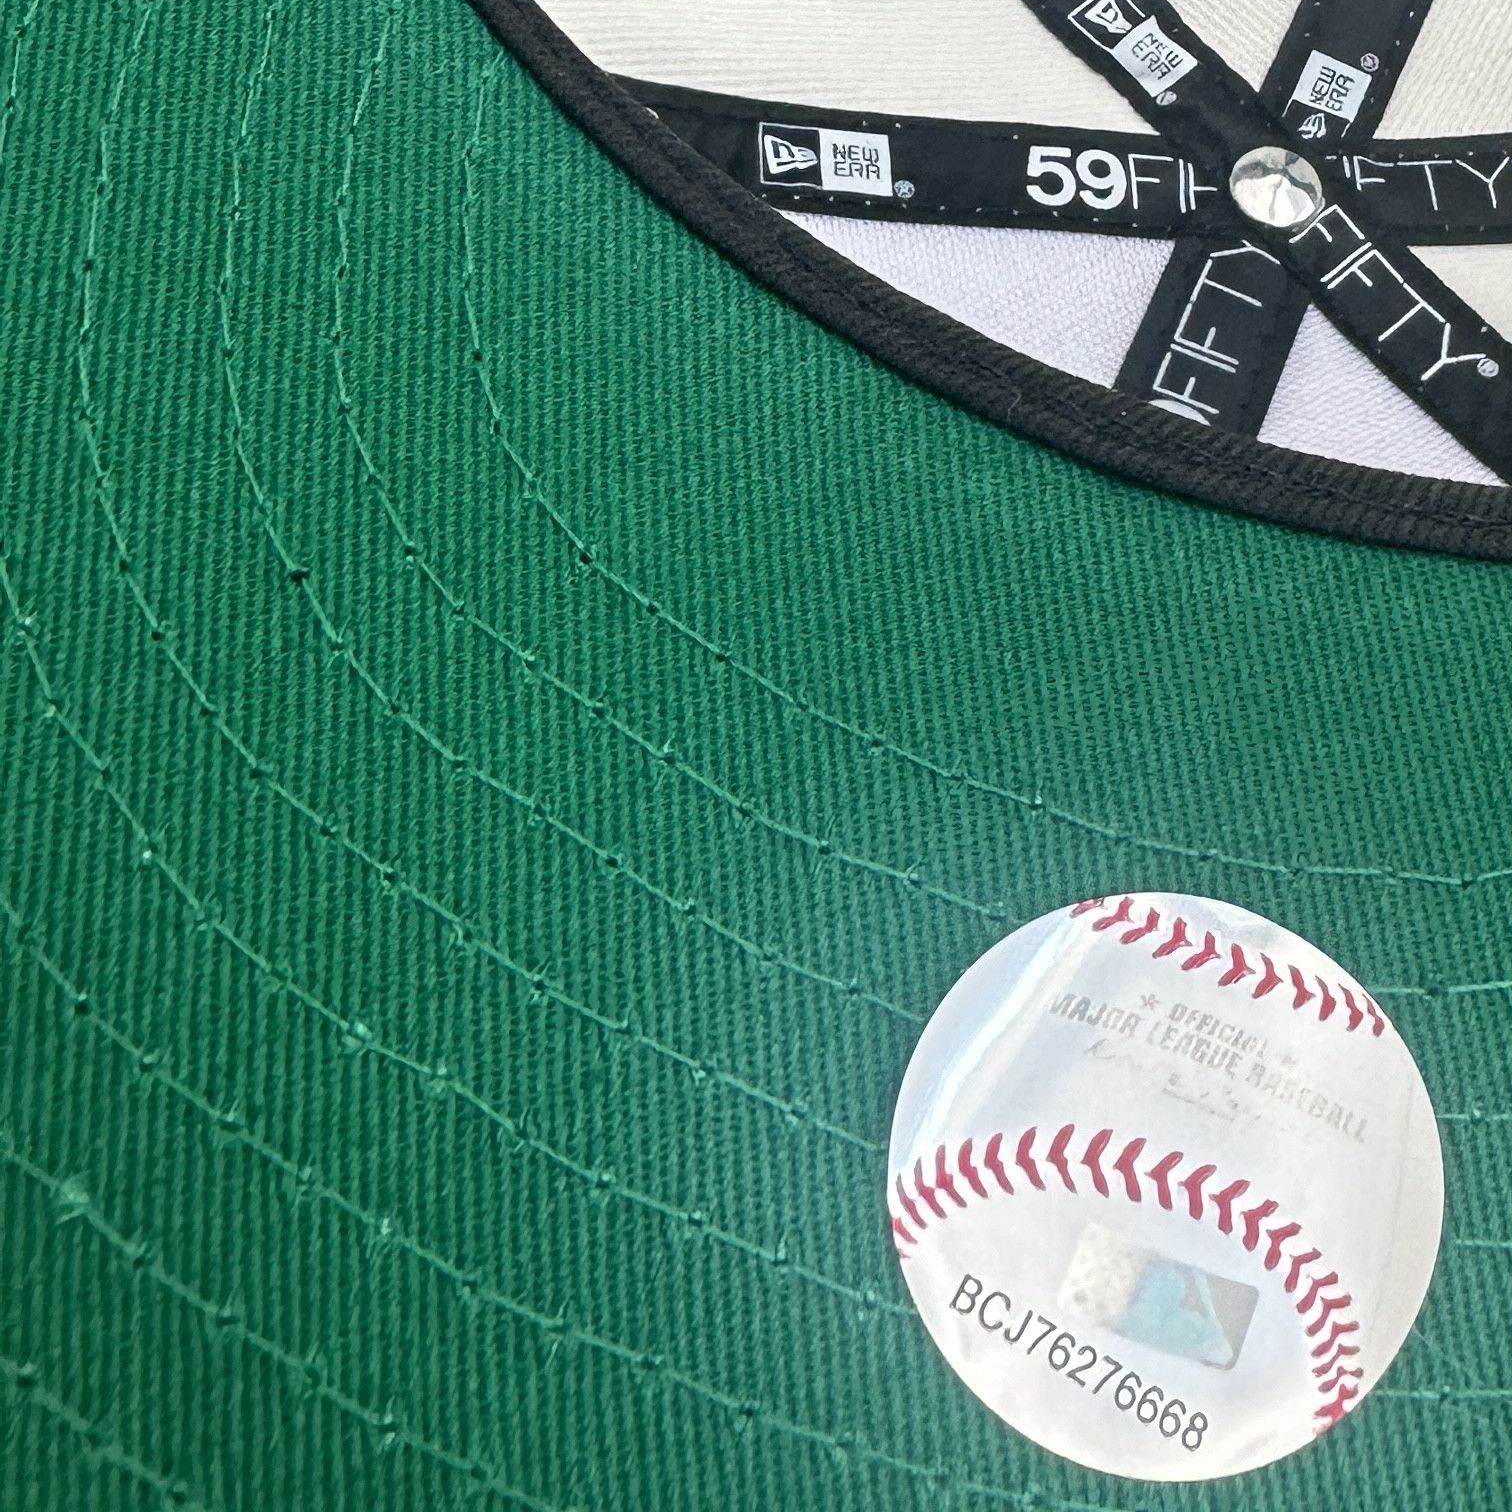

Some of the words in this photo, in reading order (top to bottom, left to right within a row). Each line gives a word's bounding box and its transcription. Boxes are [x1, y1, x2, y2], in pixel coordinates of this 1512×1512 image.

[832, 142, 880, 164] NEW
[833, 160, 881, 181] ERA
[1148, 238, 1281, 426] FIFTY
[1289, 204, 1487, 382] FIFTY
[1049, 993, 1142, 1037] MAJOR
[1146, 1020, 1245, 1080] LEAGUE
[949, 1273, 1208, 1452] BCJ76276668
